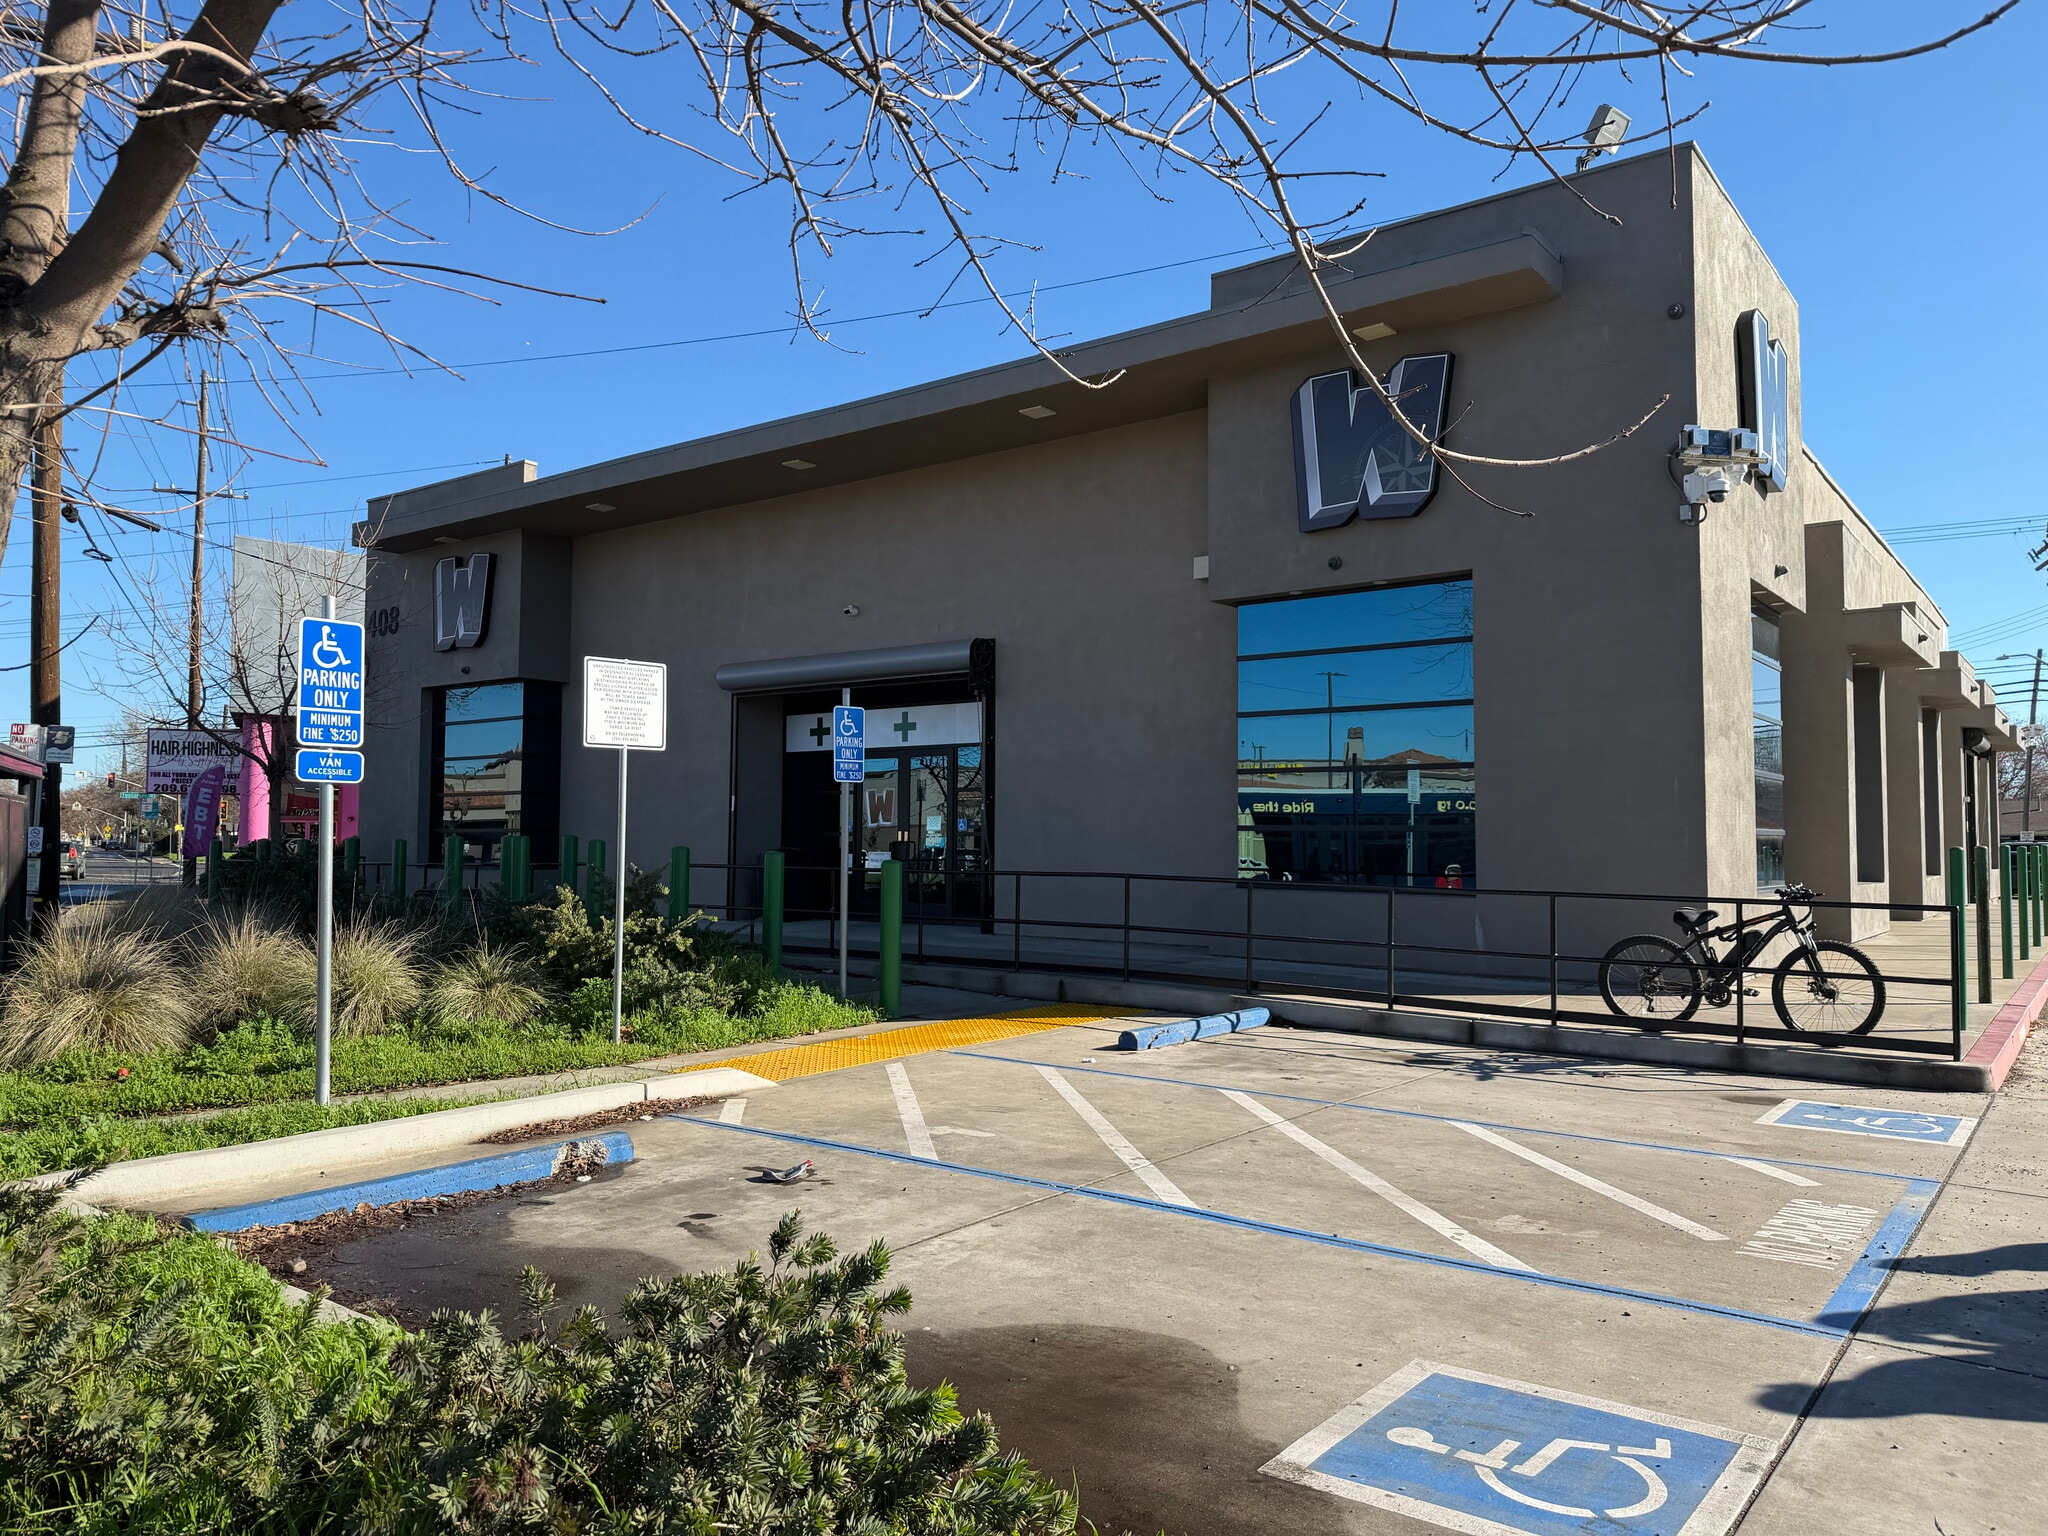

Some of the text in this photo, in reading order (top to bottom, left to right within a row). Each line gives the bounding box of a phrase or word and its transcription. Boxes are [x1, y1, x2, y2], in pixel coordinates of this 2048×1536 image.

[1290, 351, 1455, 533] W
[434, 553, 497, 652] W
[368, 607, 399, 637] 408
[304, 669, 359, 689] PARKING
[314, 690, 349, 708] ONLY
[310, 713, 351, 726] MINIMUM
[12, 725, 23, 733] NO
[303, 727, 357, 741] FINE $250
[12, 736, 38, 744] PARKING
[836, 736, 862, 748] PARKING
[152, 740, 240, 756] HAIR HIGHNESS
[842, 748, 857, 759] ONLY
[320, 757, 341, 767] VAN
[308, 768, 352, 776] ACCESSIBLE
[194, 788, 212, 840] EBT
[866, 788, 895, 828] W
